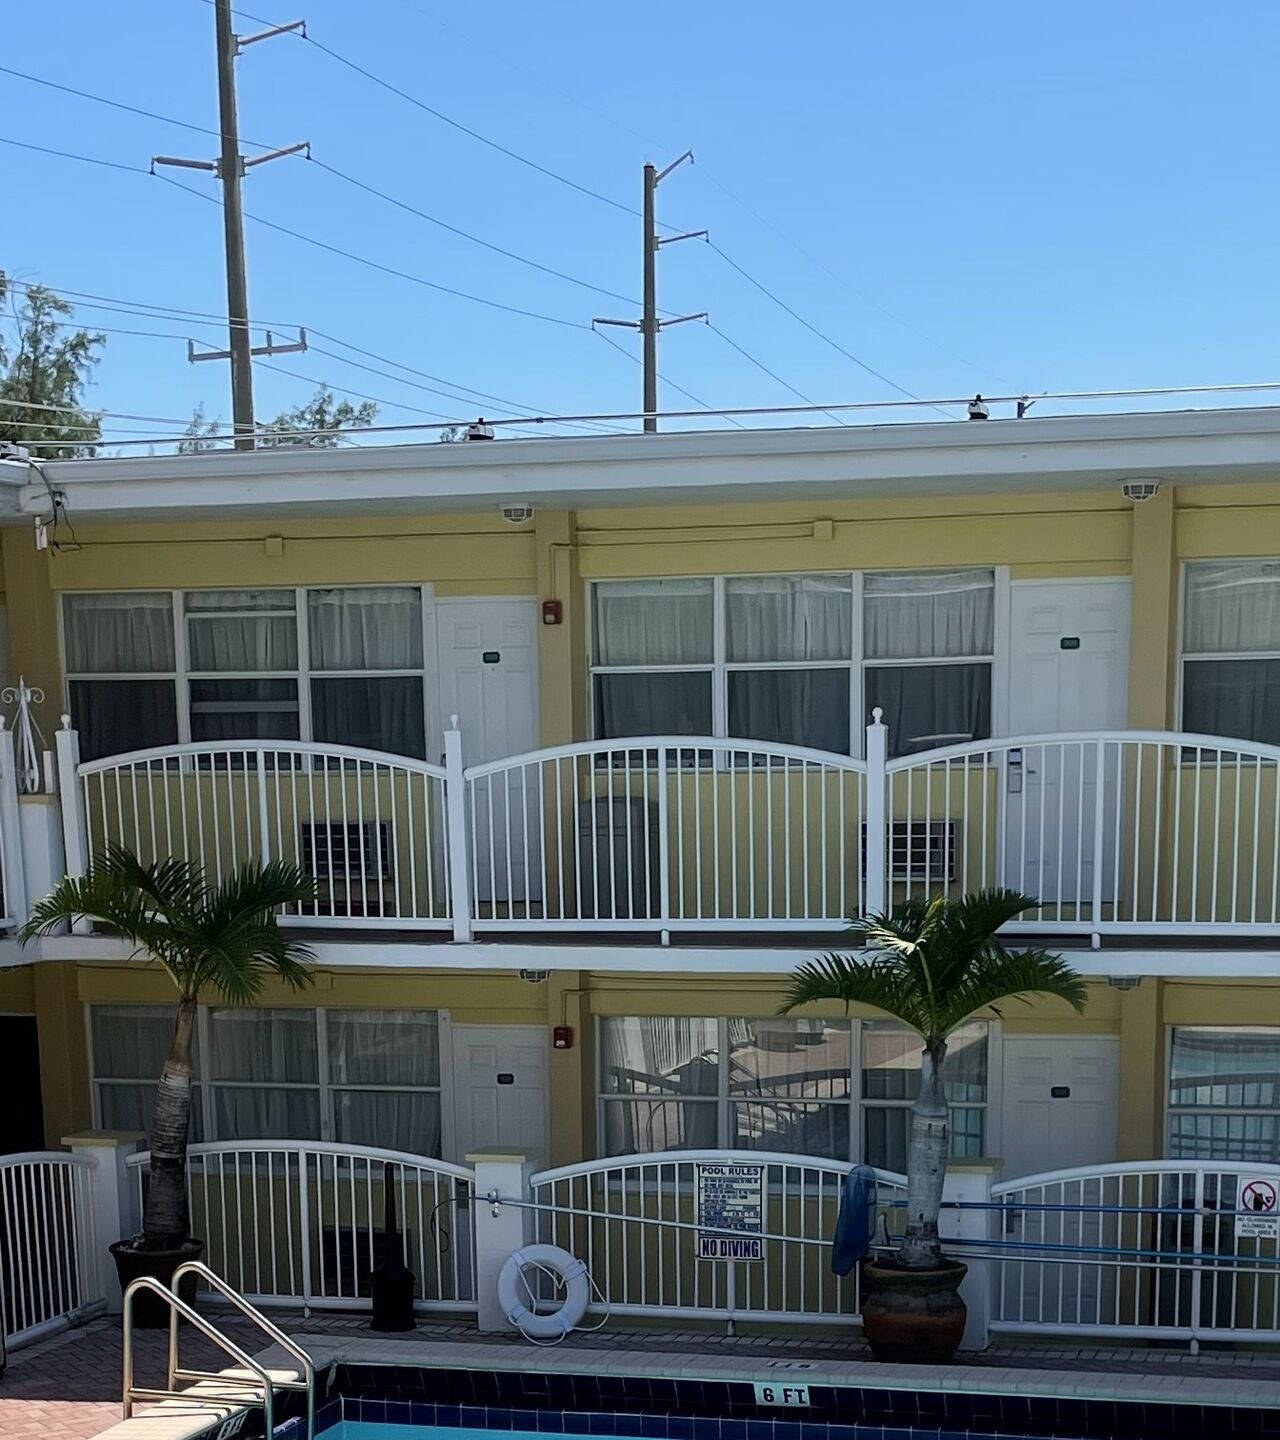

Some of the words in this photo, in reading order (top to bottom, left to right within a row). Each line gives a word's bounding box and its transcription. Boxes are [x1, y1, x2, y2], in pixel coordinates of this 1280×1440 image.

[701, 1167, 726, 1175] POOL
[728, 1167, 759, 1176] RULES
[702, 1239, 717, 1256] NO
[720, 1240, 759, 1258] DIVING
[762, 1387, 775, 1403] 6
